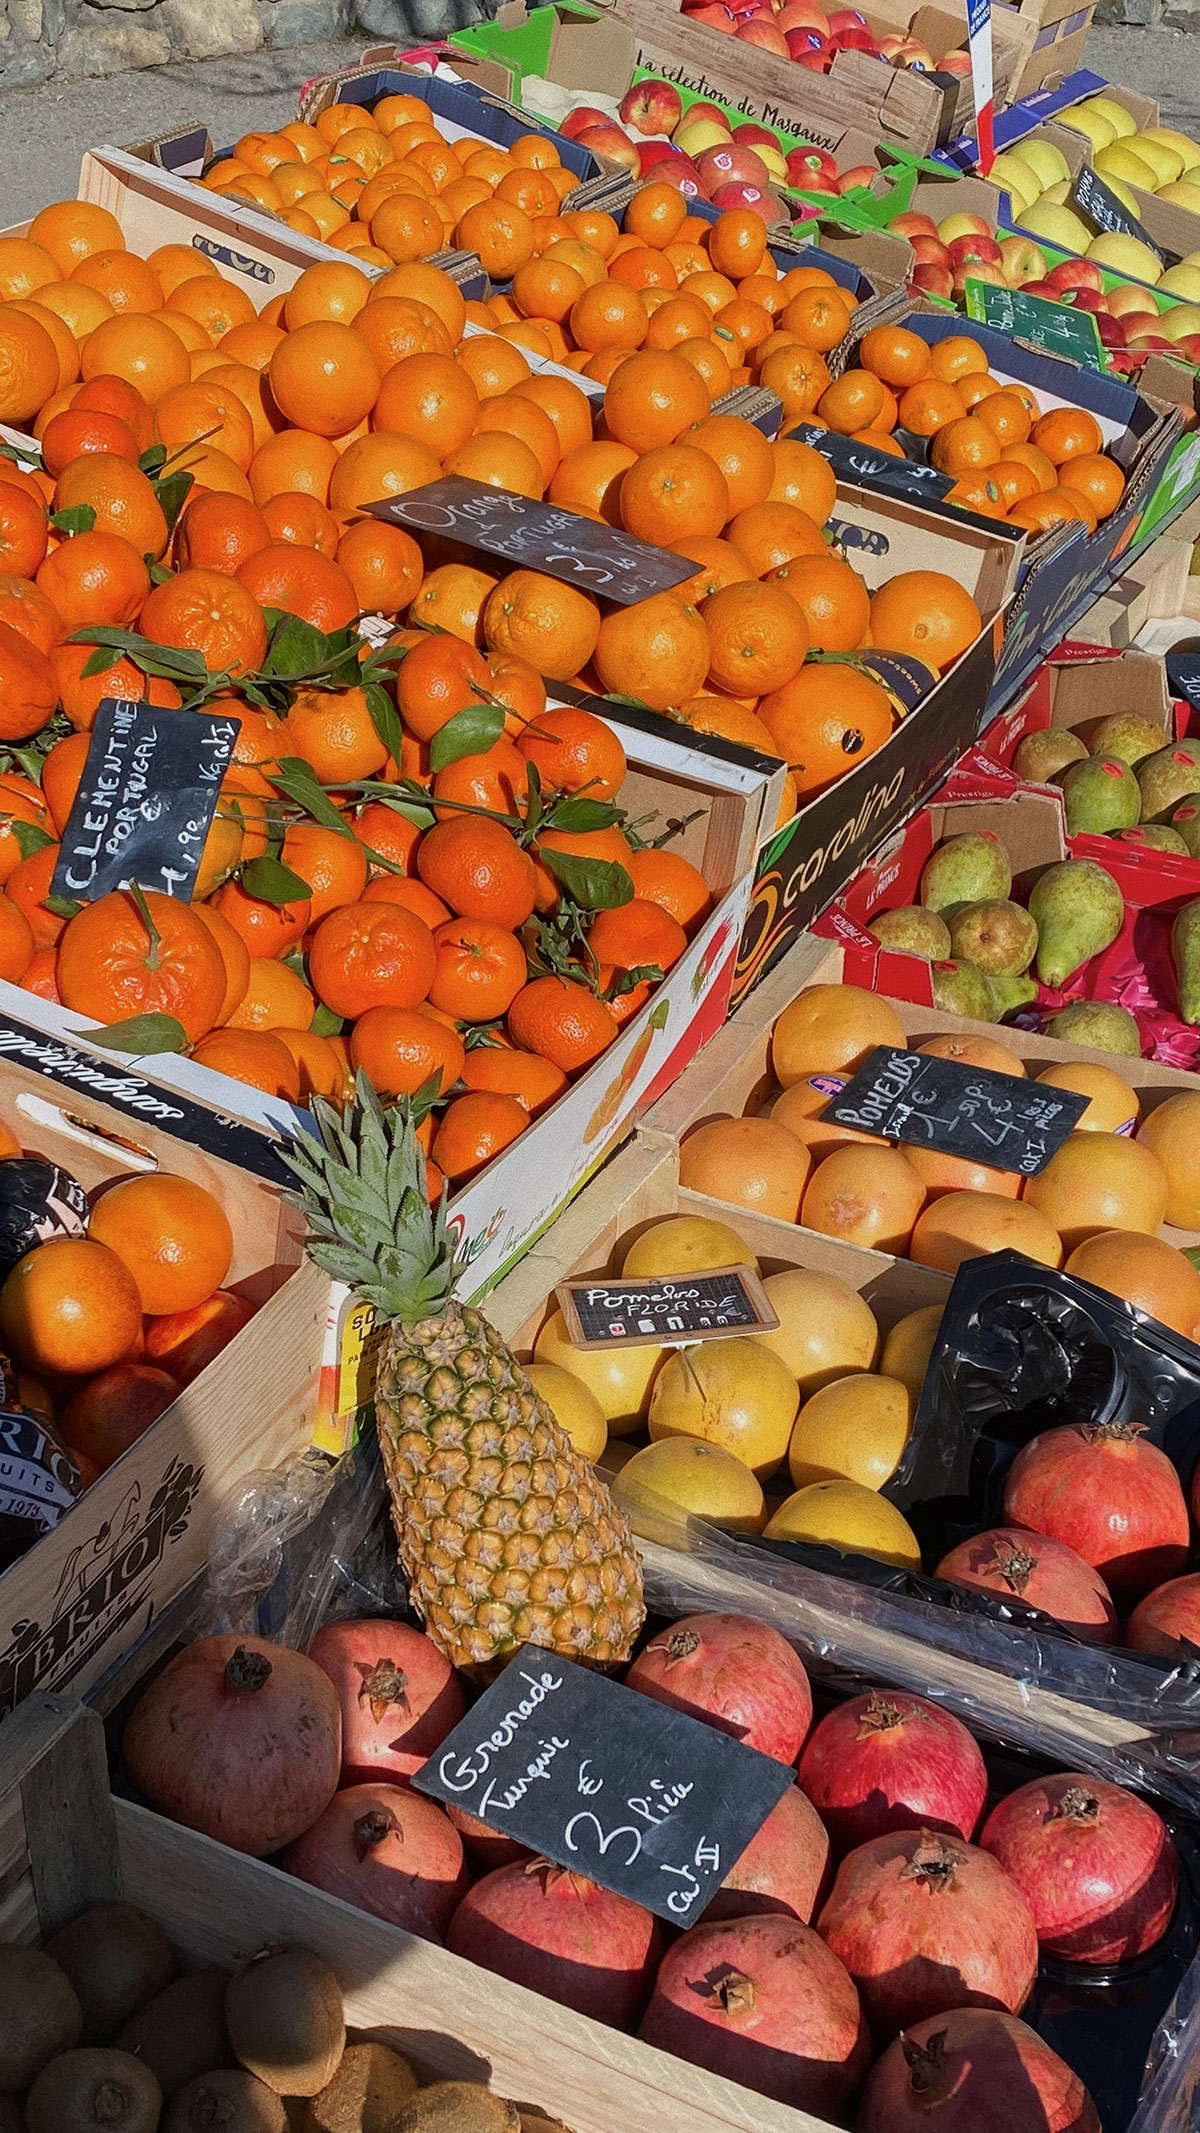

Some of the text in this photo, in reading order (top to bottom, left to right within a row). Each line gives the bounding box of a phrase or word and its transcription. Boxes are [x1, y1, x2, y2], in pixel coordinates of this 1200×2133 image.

[661, 65, 732, 107] sélection
[737, 96, 756, 116] de
[390, 494, 523, 528] Orange
[105, 725, 158, 855] PORTUGAL
[783, 767, 905, 908] carolino
[835, 1052, 921, 1127] POMELOS
[586, 1284, 700, 1308] Pomelos
[0, 1419, 81, 1485] RIO
[0, 1461, 55, 1494] UITS
[33, 1536, 149, 1679] BRIO
[50, 1590, 128, 1678] FRUITS
[439, 1671, 563, 1792] Grenade
[478, 1735, 570, 1818] Turquie
[564, 1810, 643, 1867] 3
